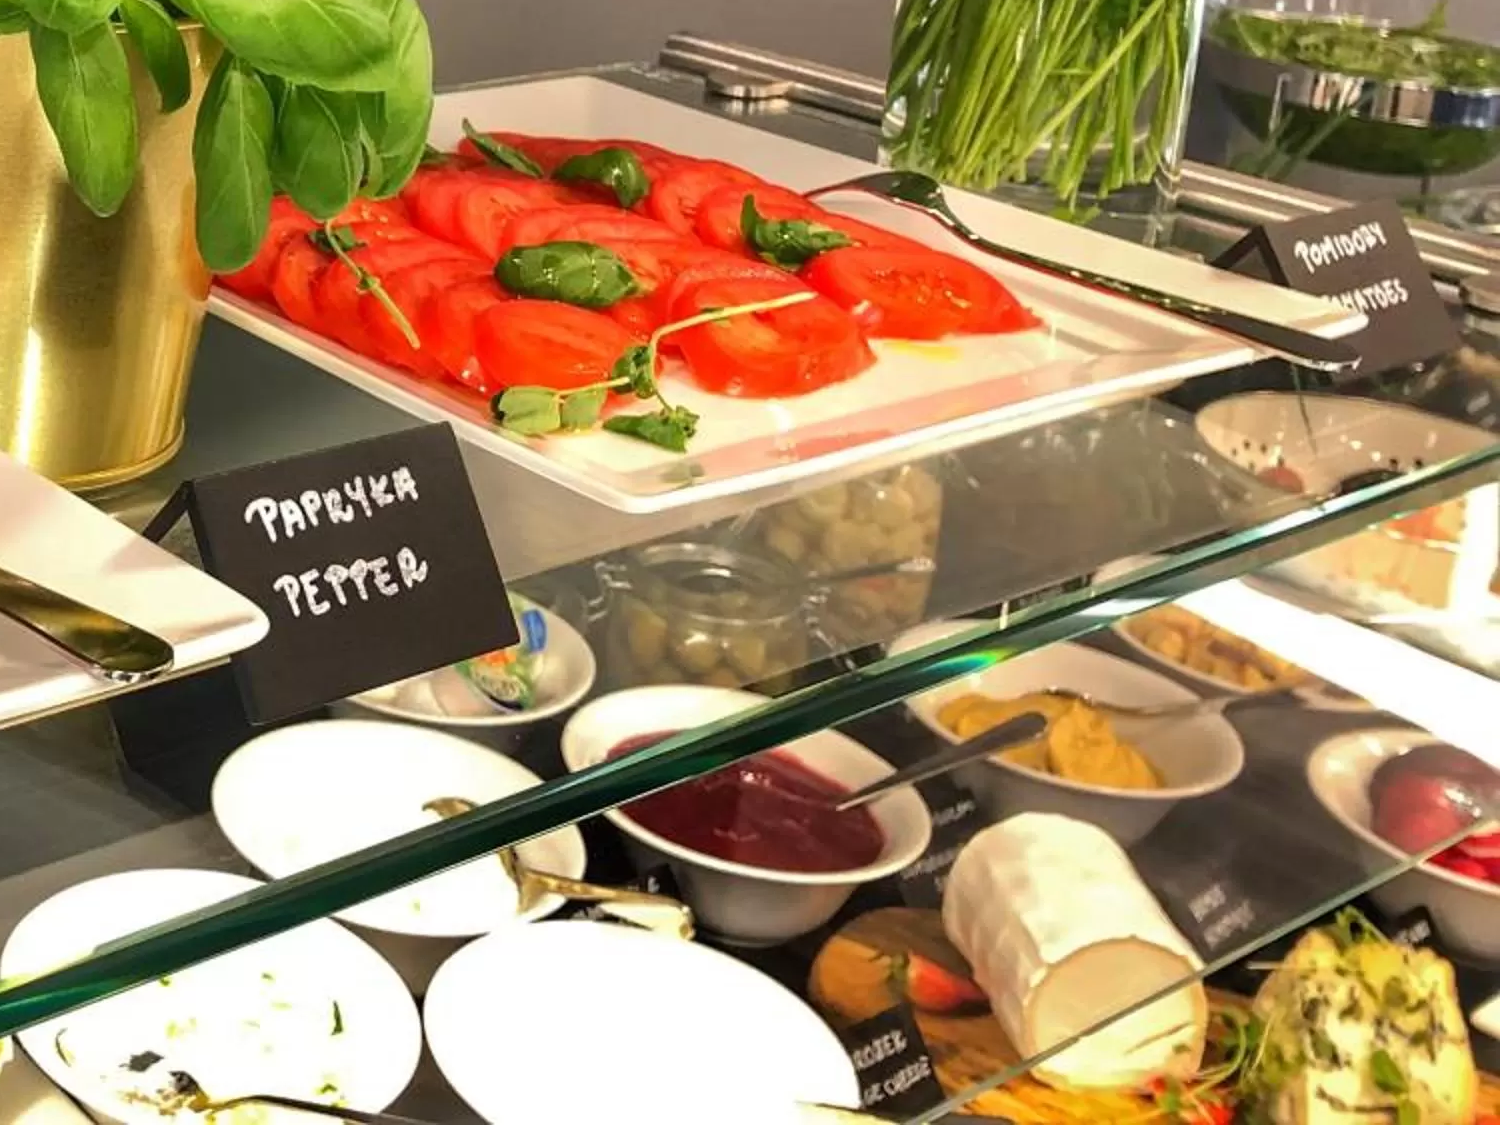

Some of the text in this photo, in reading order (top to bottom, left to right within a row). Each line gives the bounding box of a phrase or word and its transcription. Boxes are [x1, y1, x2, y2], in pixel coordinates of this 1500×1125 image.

[1293, 221, 1387, 274] POMIDORY
[1319, 277, 1409, 313] OMATOES
[244, 466, 420, 543] PAPRYKA
[273, 546, 428, 618] PEPPER
